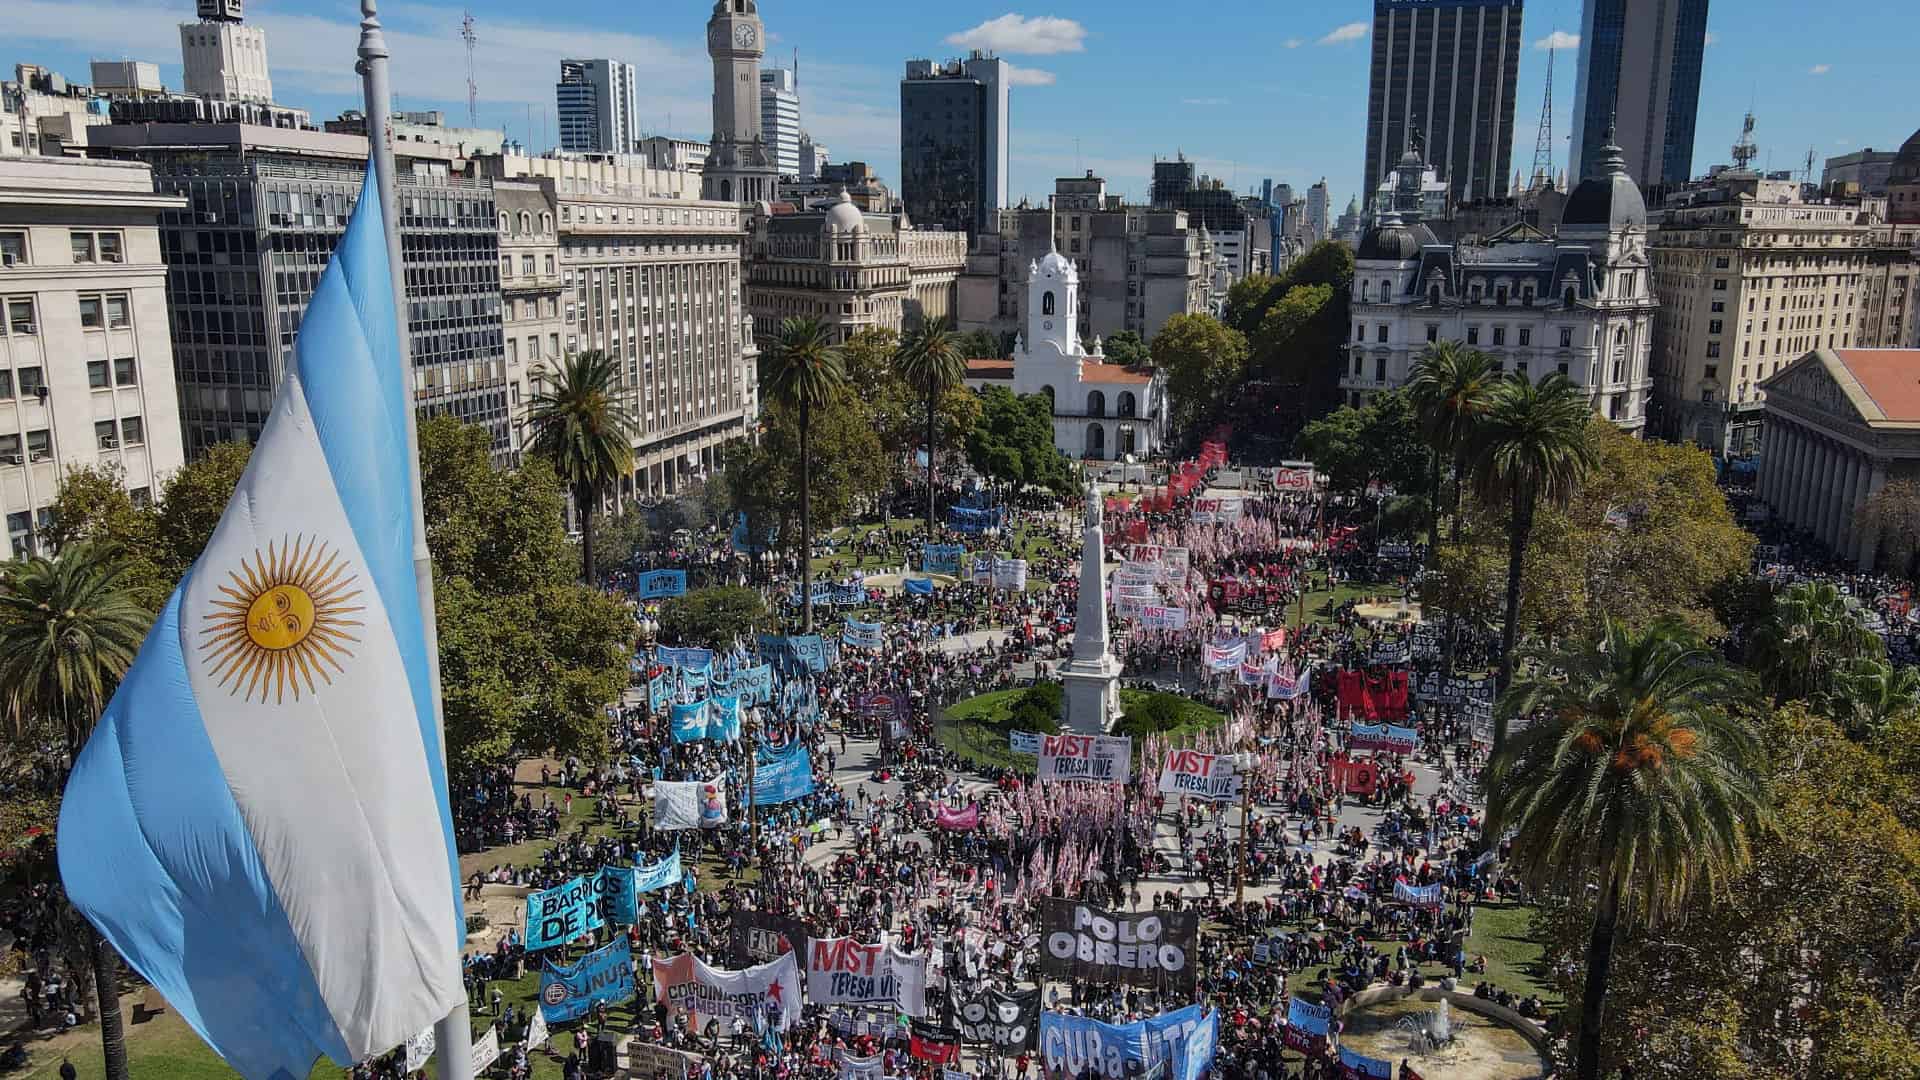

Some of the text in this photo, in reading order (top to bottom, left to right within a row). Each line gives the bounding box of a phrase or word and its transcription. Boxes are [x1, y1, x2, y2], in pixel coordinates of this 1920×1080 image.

[1195, 498, 1224, 513] MST
[1133, 545, 1164, 562] MST
[1143, 606, 1167, 617] MST
[1378, 640, 1406, 652] POLO
[1413, 636, 1436, 646] OLO
[1443, 685, 1488, 698] OBRERO
[1447, 678, 1483, 689] POLO
[1043, 735, 1095, 758] MST
[1054, 757, 1112, 776] TERESA VIVE
[1165, 750, 1215, 777] MST
[1174, 773, 1208, 793] TERESA
[542, 876, 621, 917] BARRIOS
[541, 907, 579, 942] DE
[1074, 905, 1162, 944] POLO
[812, 938, 884, 977] MST
[1048, 931, 1185, 972] OBRERO
[684, 997, 733, 1017] CMBIO
